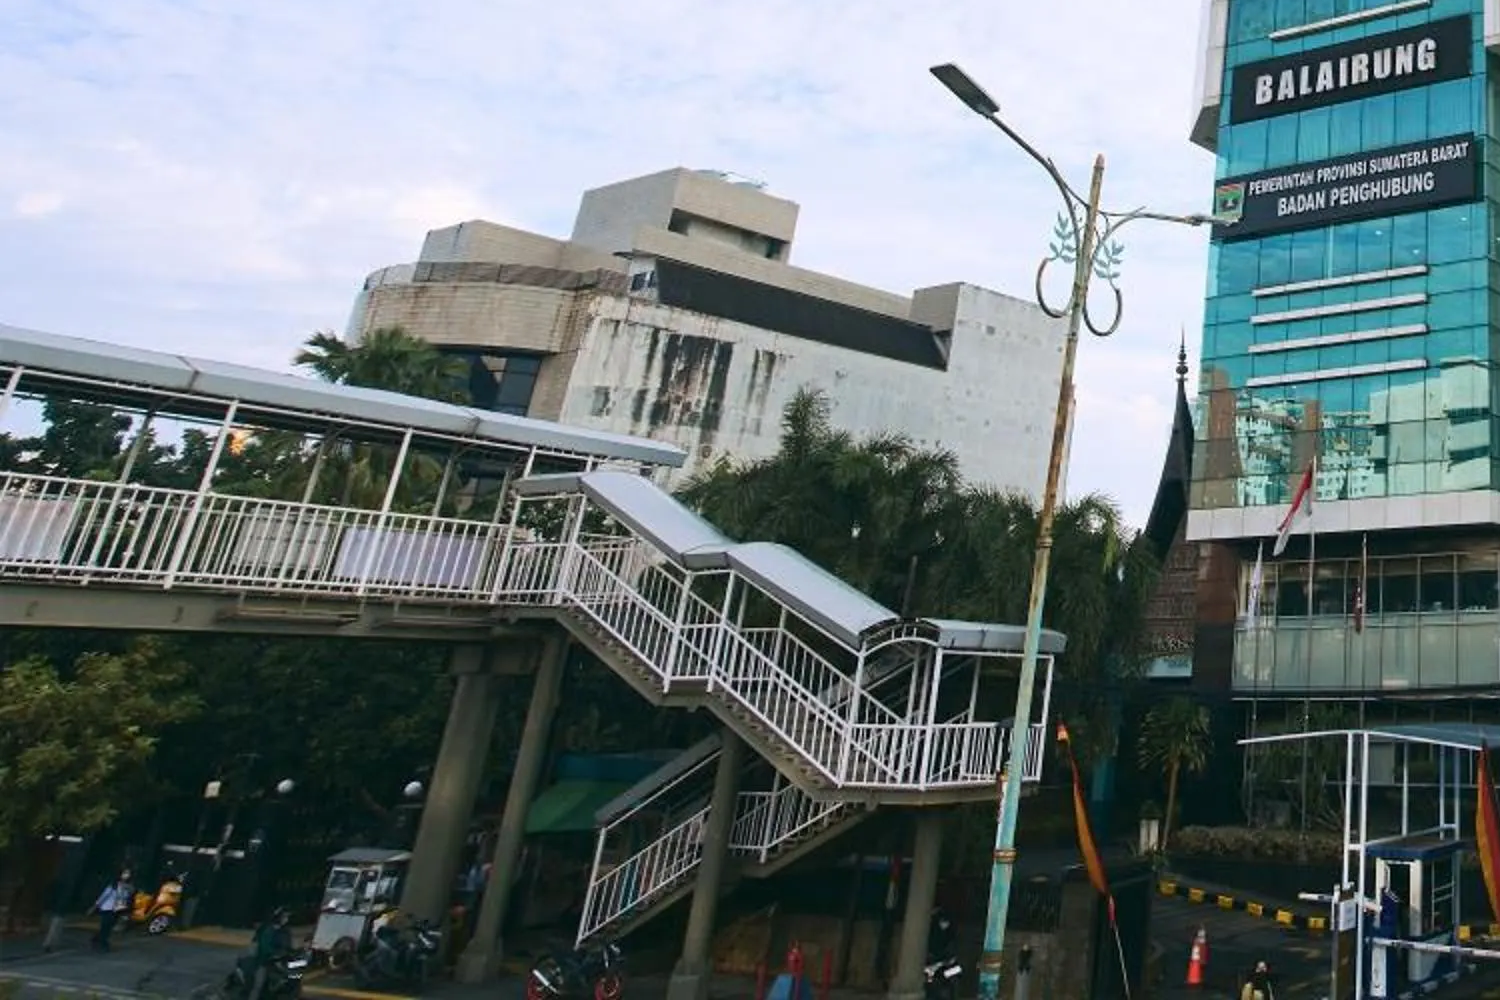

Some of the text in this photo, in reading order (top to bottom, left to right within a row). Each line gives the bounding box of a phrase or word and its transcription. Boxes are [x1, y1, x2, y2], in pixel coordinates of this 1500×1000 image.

[1255, 37, 1437, 105] BALAIRUNG
[1249, 142, 1469, 196] PEMERINTAH PROVINSI SUMATERA BARAT
[1277, 171, 1435, 217] BADAN PENGHUBUNG
